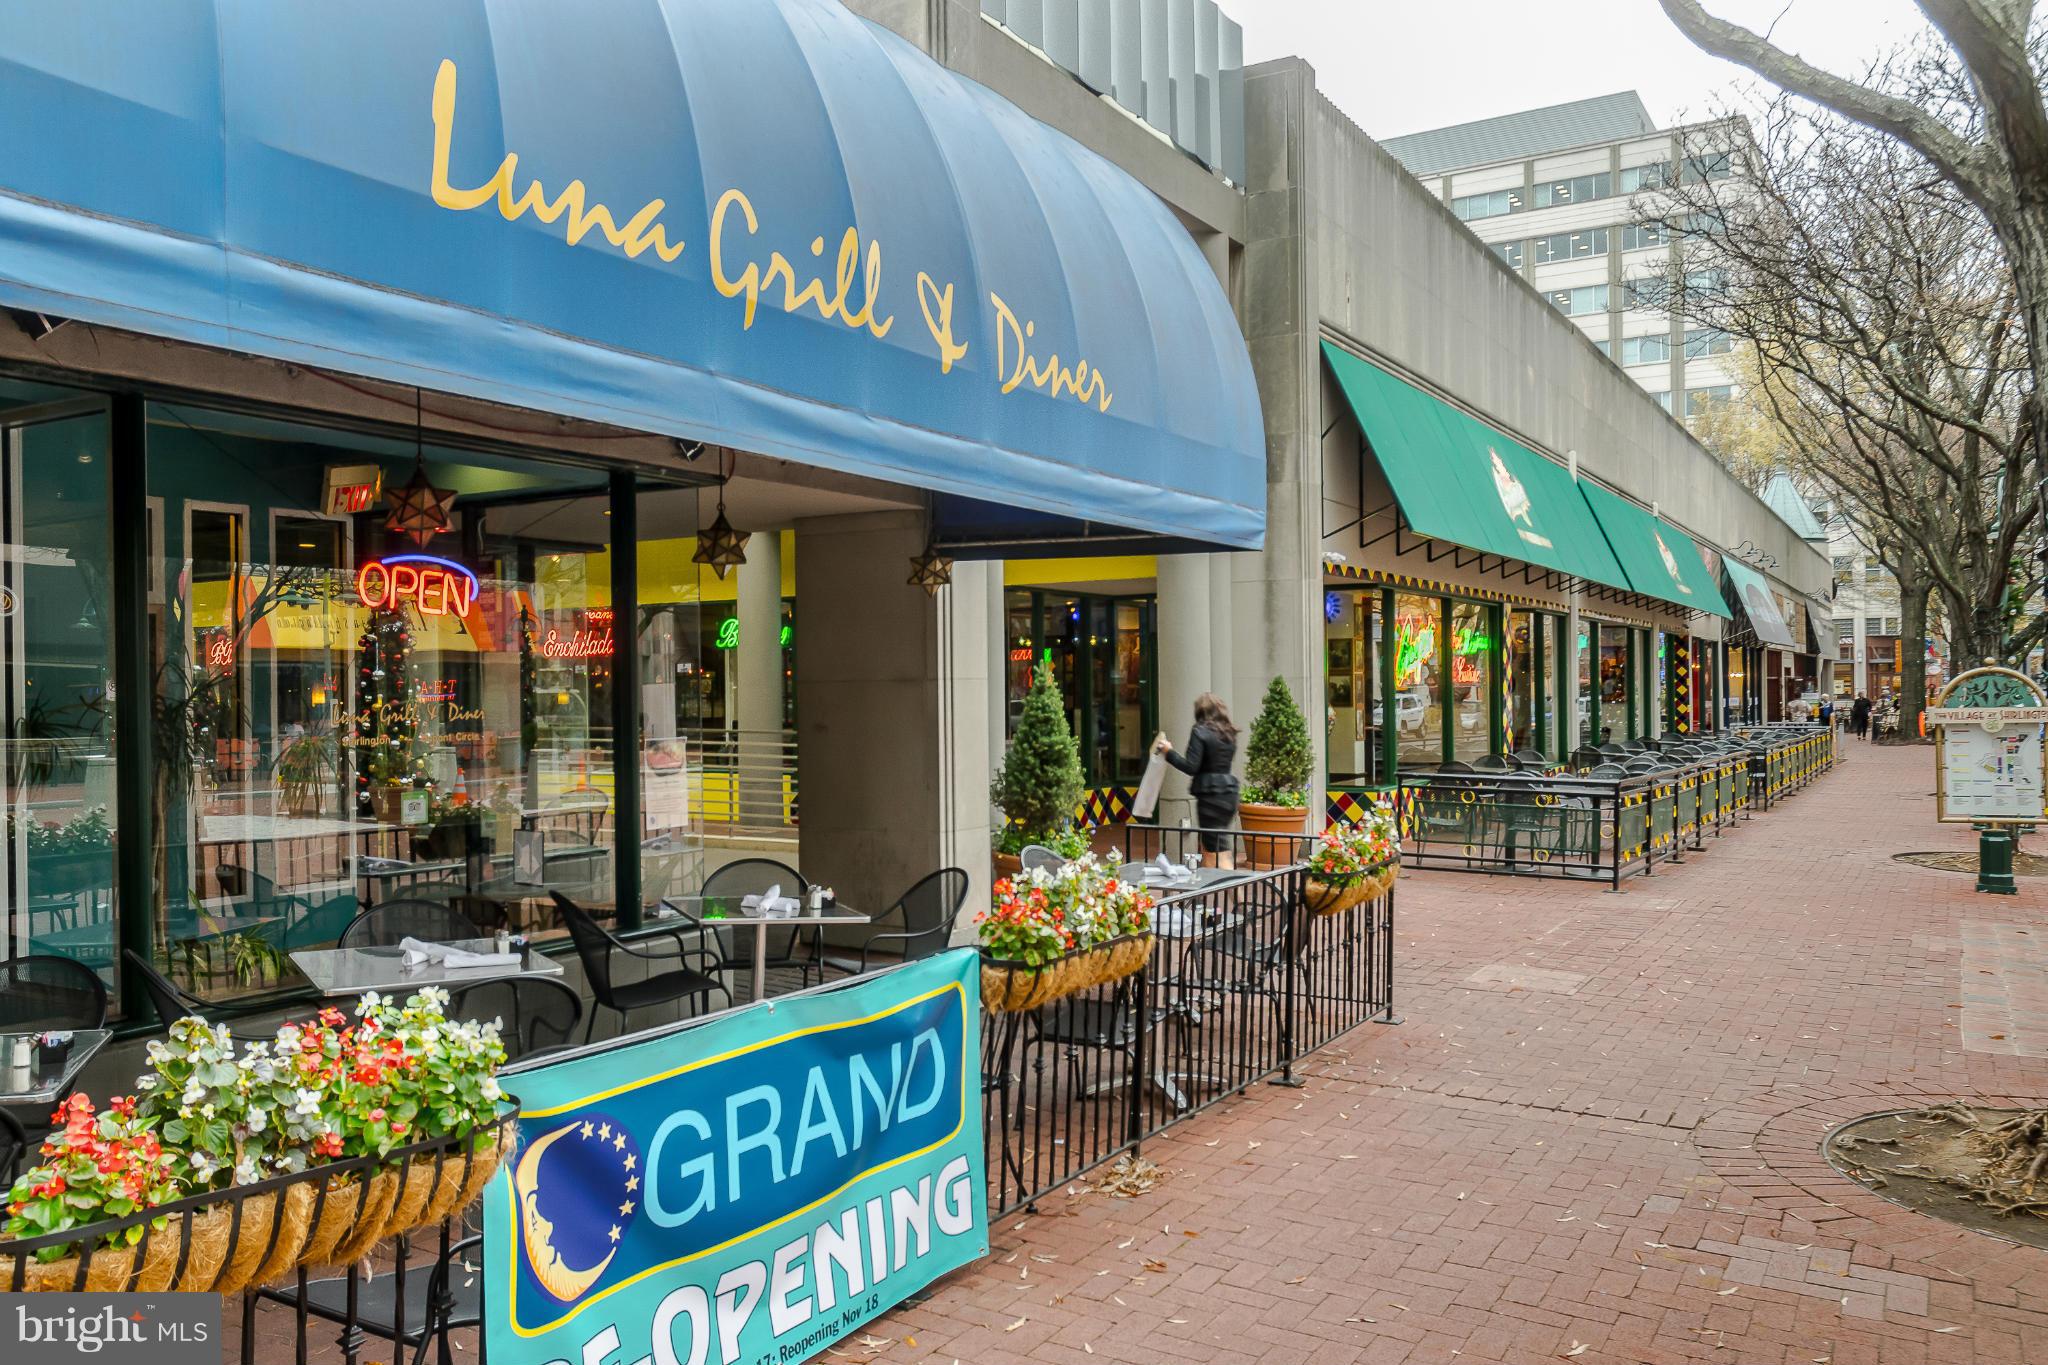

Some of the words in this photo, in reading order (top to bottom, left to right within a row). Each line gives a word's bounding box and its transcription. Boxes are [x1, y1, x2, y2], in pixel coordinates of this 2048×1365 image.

[431, 58, 686, 262] Luna
[709, 188, 895, 338] Grill
[916, 270, 969, 375] &
[990, 290, 1113, 413] Diner
[358, 561, 471, 618] OPEN
[380, 703, 419, 726] Grill
[449, 702, 485, 721] Diner
[1948, 711, 1985, 721] VILLAGE
[642, 1027, 946, 1228] GRAND
[541, 1155, 974, 1365] OPENING
[779, 1319, 839, 1362] Reopening
[842, 1305, 862, 1329] Nov
[865, 1293, 879, 1314] 18
